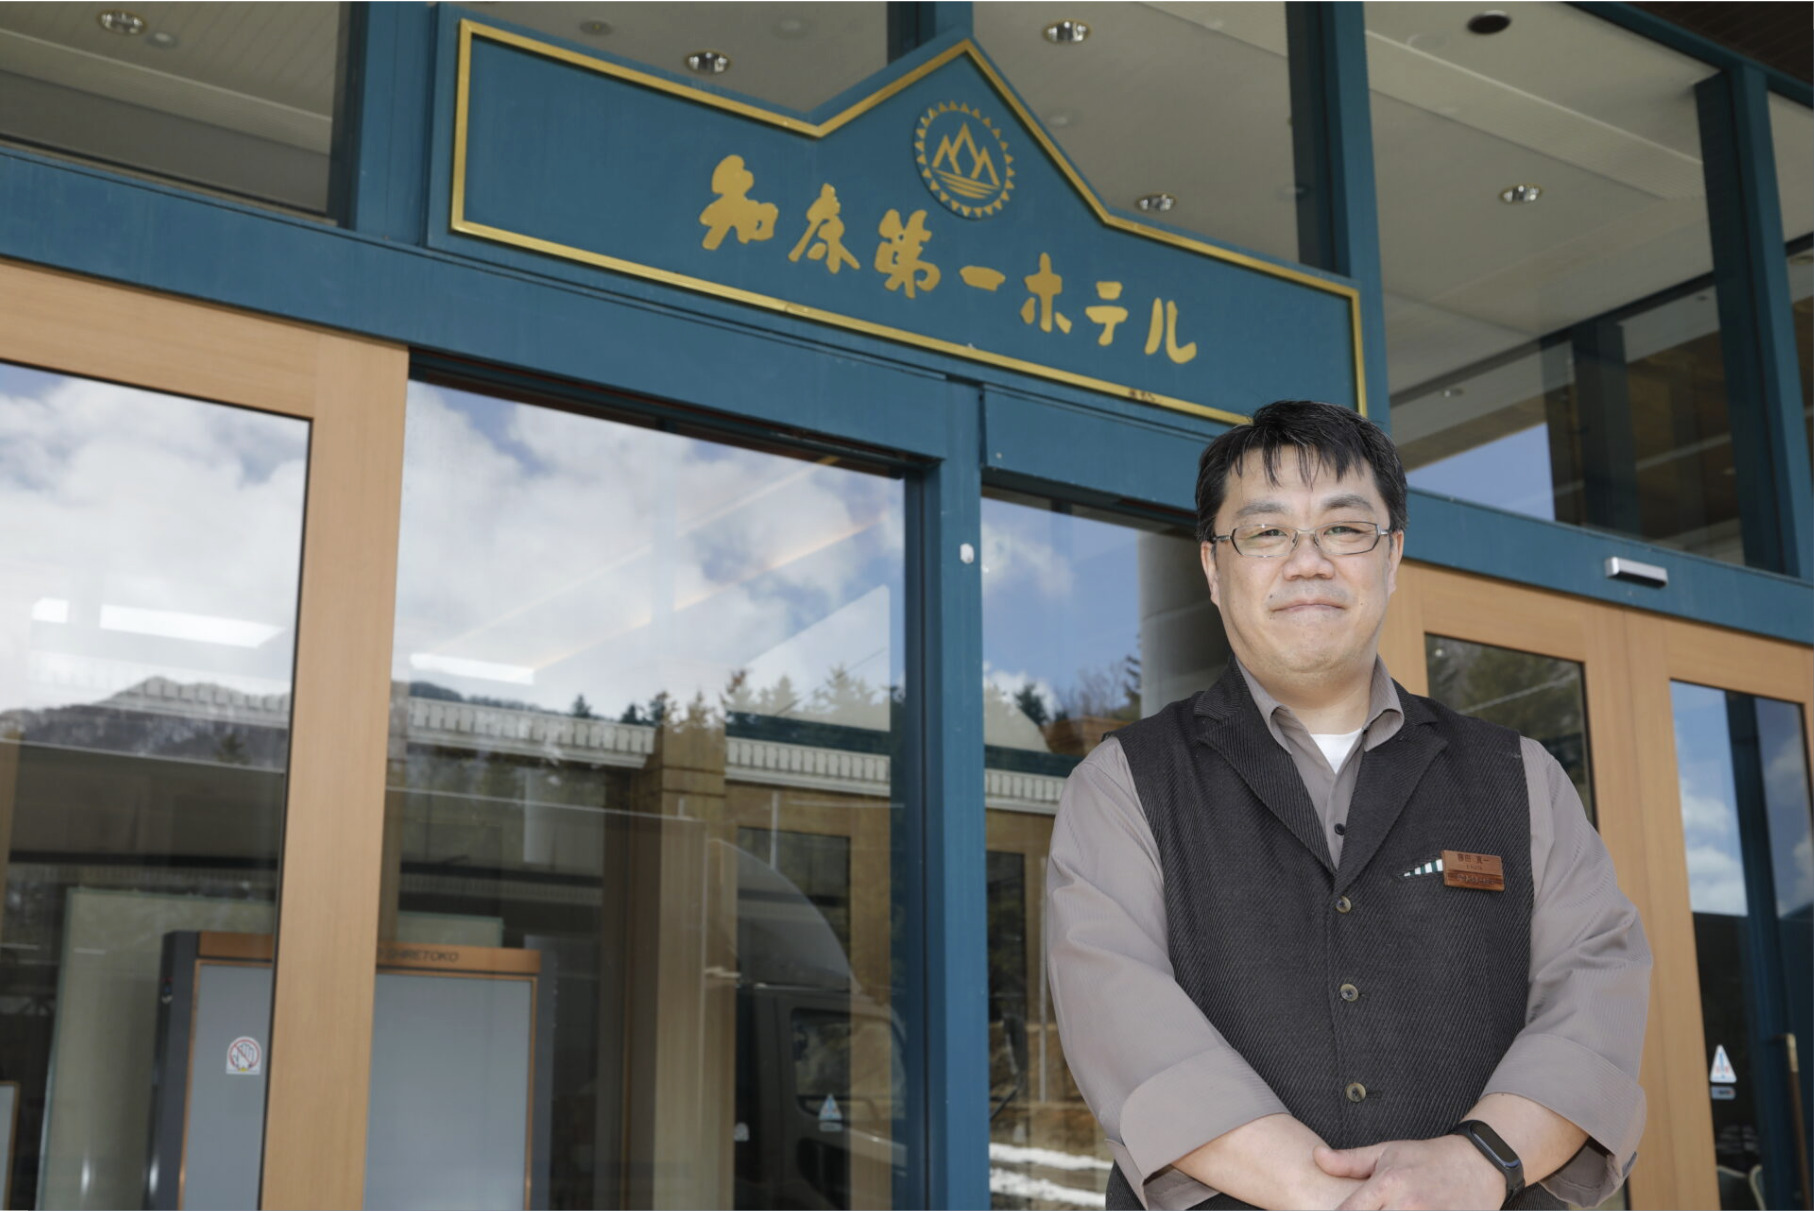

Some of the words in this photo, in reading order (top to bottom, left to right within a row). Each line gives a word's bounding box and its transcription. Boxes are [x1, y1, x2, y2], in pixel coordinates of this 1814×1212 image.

[700, 155, 1197, 364] 知床第一ホテル
